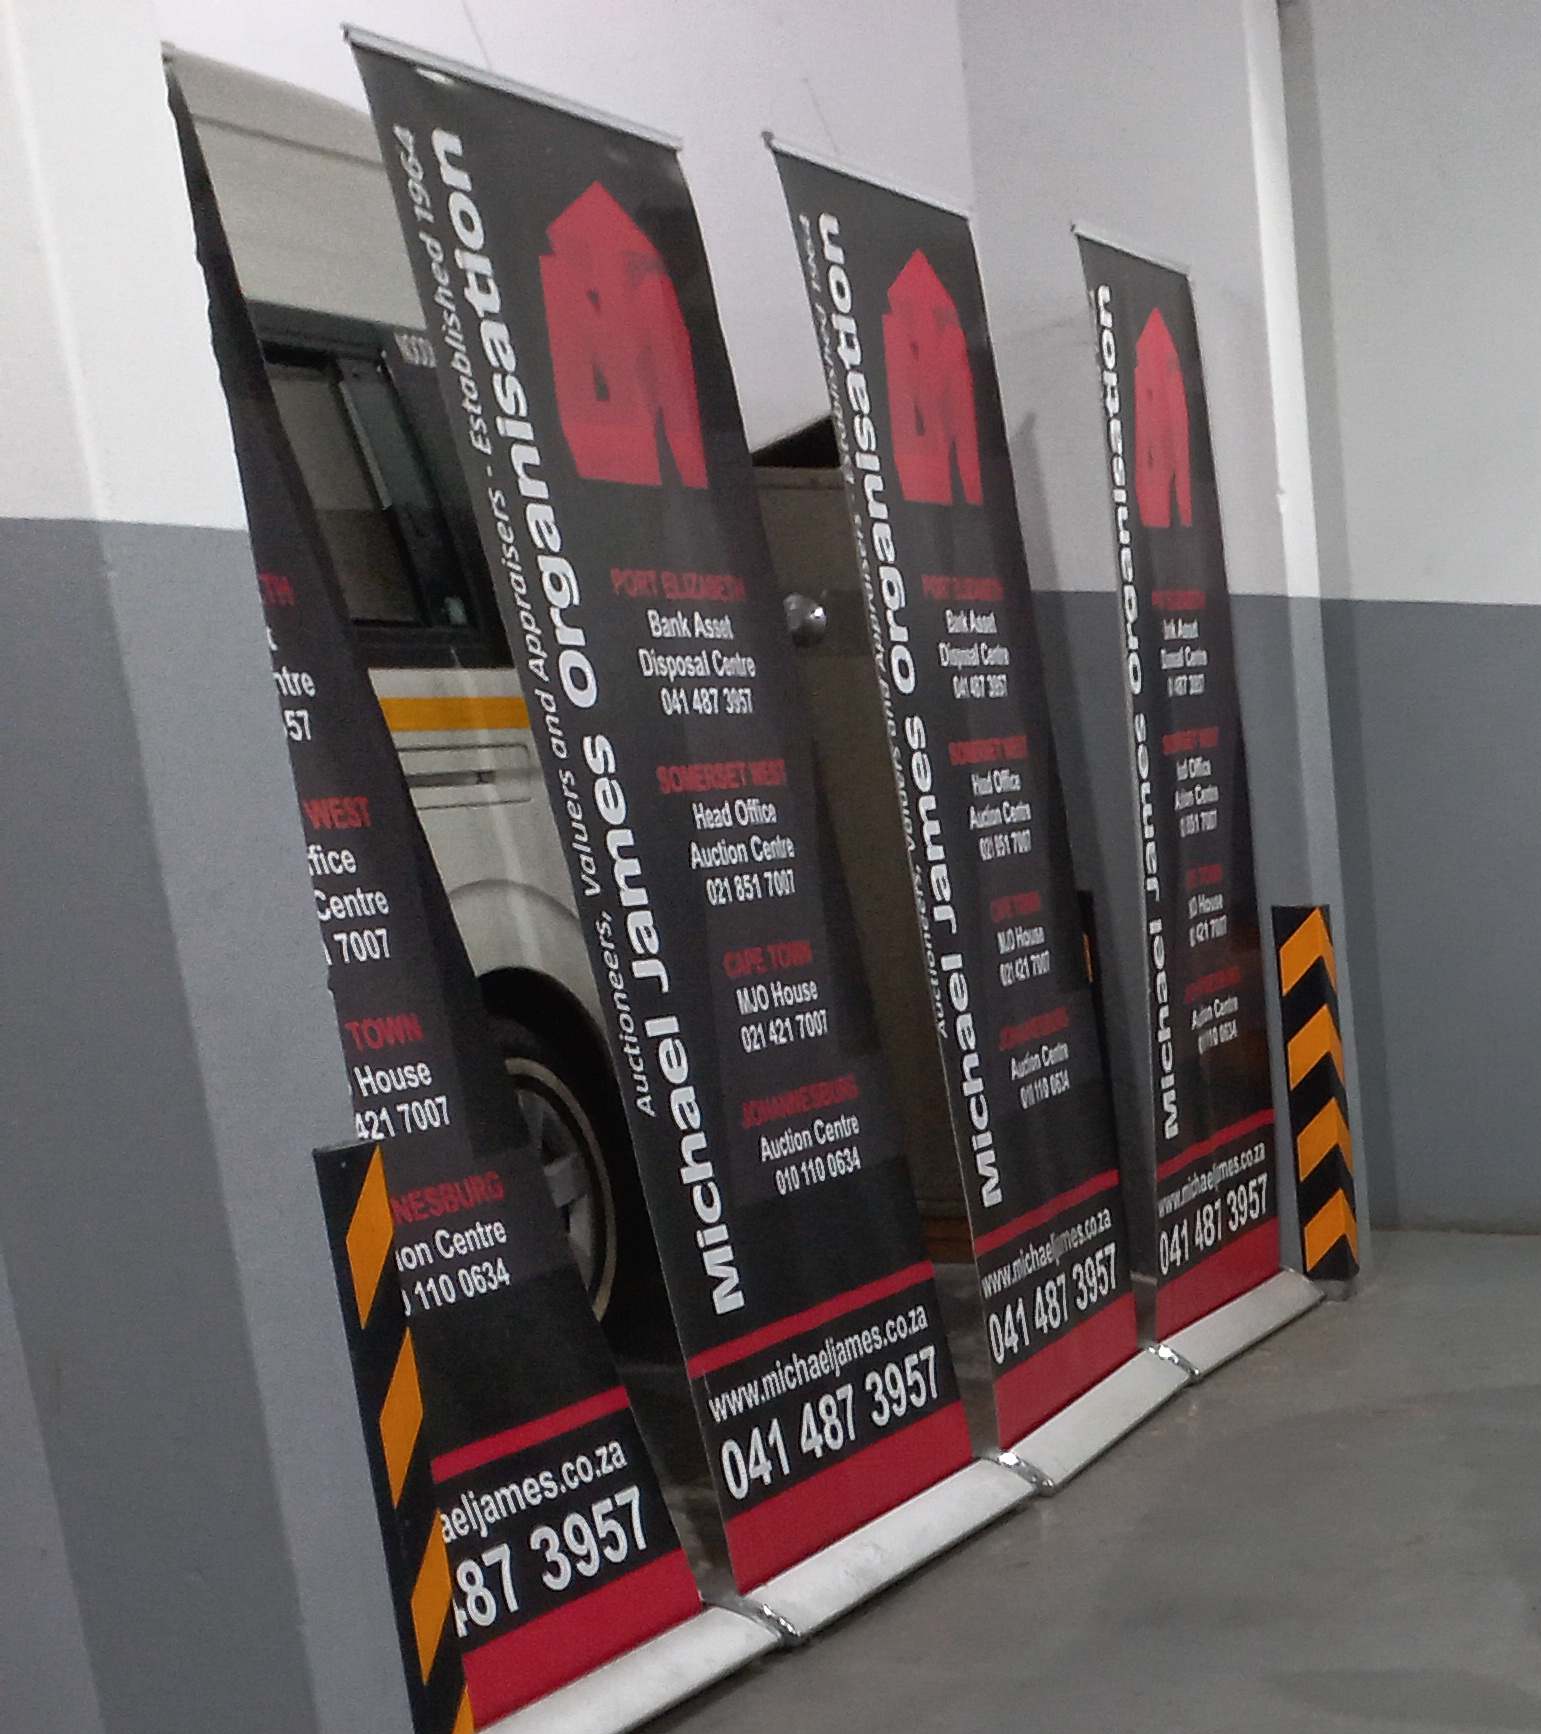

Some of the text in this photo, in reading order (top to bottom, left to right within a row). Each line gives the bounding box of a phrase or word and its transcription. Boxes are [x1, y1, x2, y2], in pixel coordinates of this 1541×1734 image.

[419, 231, 492, 455] Established
[488, 487, 549, 683] Appraisers
[647, 608, 734, 640] Bank Asset
[638, 648, 757, 683] Disposal Centre
[431, 128, 745, 1315] Michael James Organisation
[534, 688, 567, 758] and
[660, 687, 690, 715] 041
[692, 687, 719, 714] 487
[819, 212, 1001, 1208] Michael James Organisation
[304, 795, 372, 830] WEST
[559, 769, 600, 896] Valuers
[692, 798, 777, 829] Head Office
[690, 834, 795, 870] Auction Centre
[706, 869, 796, 906] 021 851 7007
[333, 927, 390, 965] 7007
[595, 911, 657, 1117] Auctioneers,
[736, 980, 818, 1016] MJO House
[344, 1014, 424, 1051] TOWN
[741, 1009, 828, 1053] 021 421 7007
[353, 1062, 433, 1097] House
[355, 1095, 450, 1140] 421 7007
[760, 1114, 860, 1162] Auction Centre
[775, 1147, 861, 1195] 010 110 0634
[434, 1221, 507, 1259] Centre
[1159, 1172, 1268, 1276] 041 487 3957
[414, 1274, 456, 1310] 110
[457, 1257, 510, 1298] 0634
[989, 1242, 1116, 1364] 041 487 3957
[708, 1305, 928, 1424] www.michaeljames.co.za
[721, 1345, 938, 1500] 041 487 3957
[530, 1485, 647, 1591] 3957
